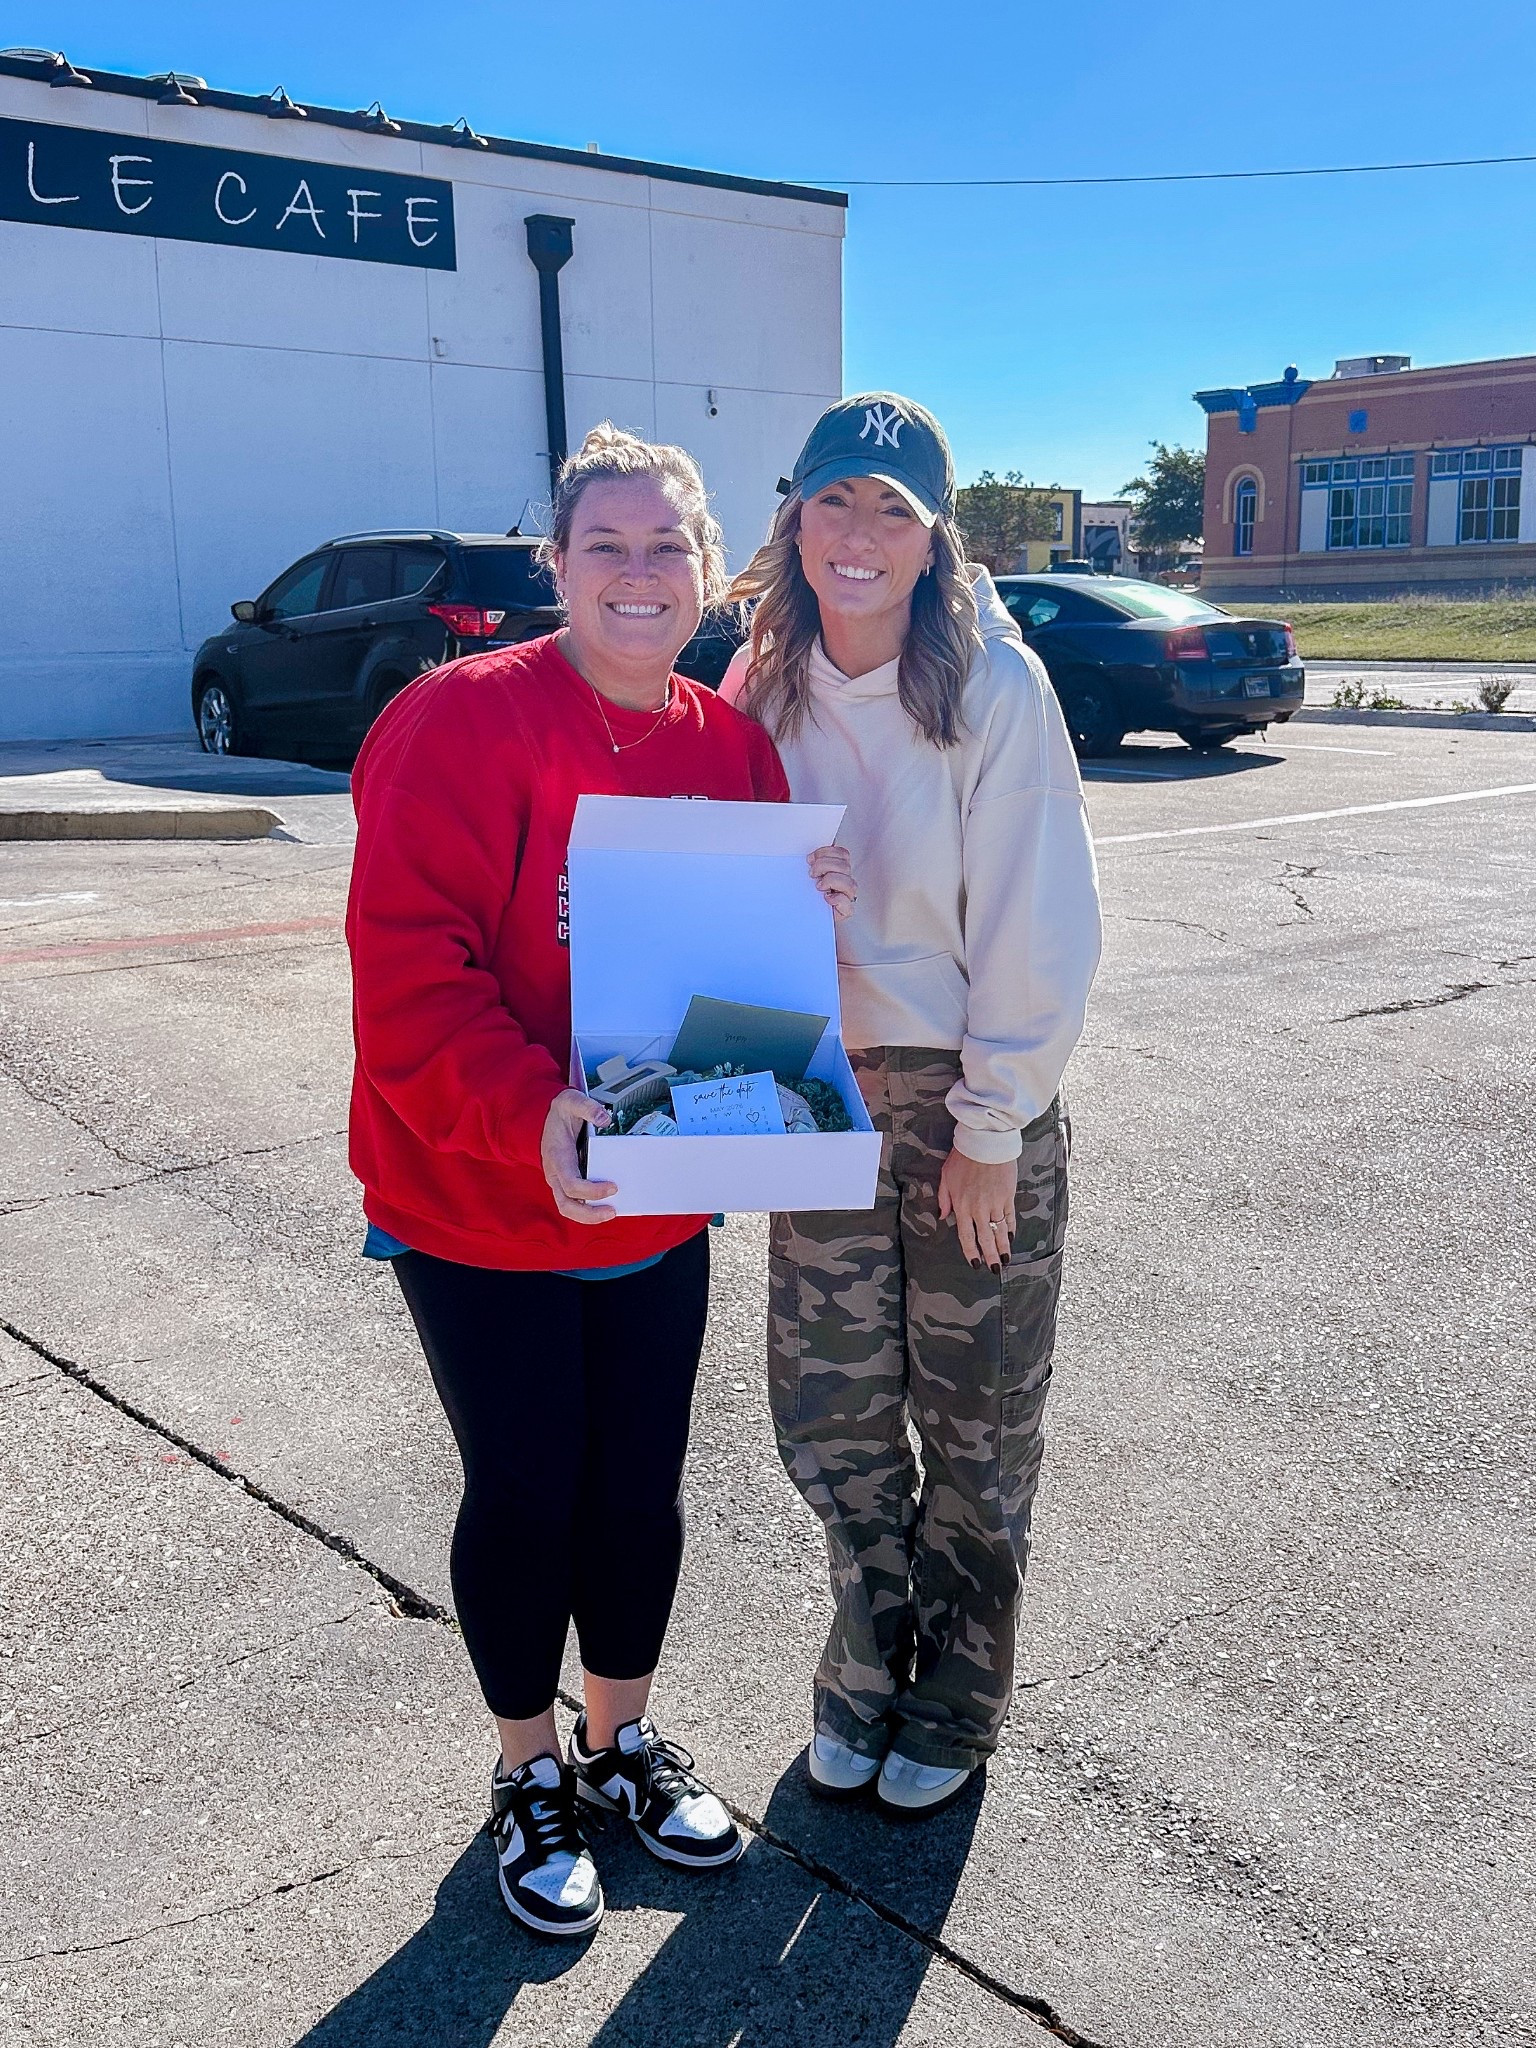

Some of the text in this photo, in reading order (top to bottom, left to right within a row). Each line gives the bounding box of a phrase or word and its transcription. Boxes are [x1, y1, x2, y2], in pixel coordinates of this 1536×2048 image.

[28, 141, 439, 247] LE CAFE
[859, 403, 905, 449] NY
[693, 1091, 718, 1105] save
[715, 1083, 734, 1103] the
[736, 1081, 758, 1099] date
